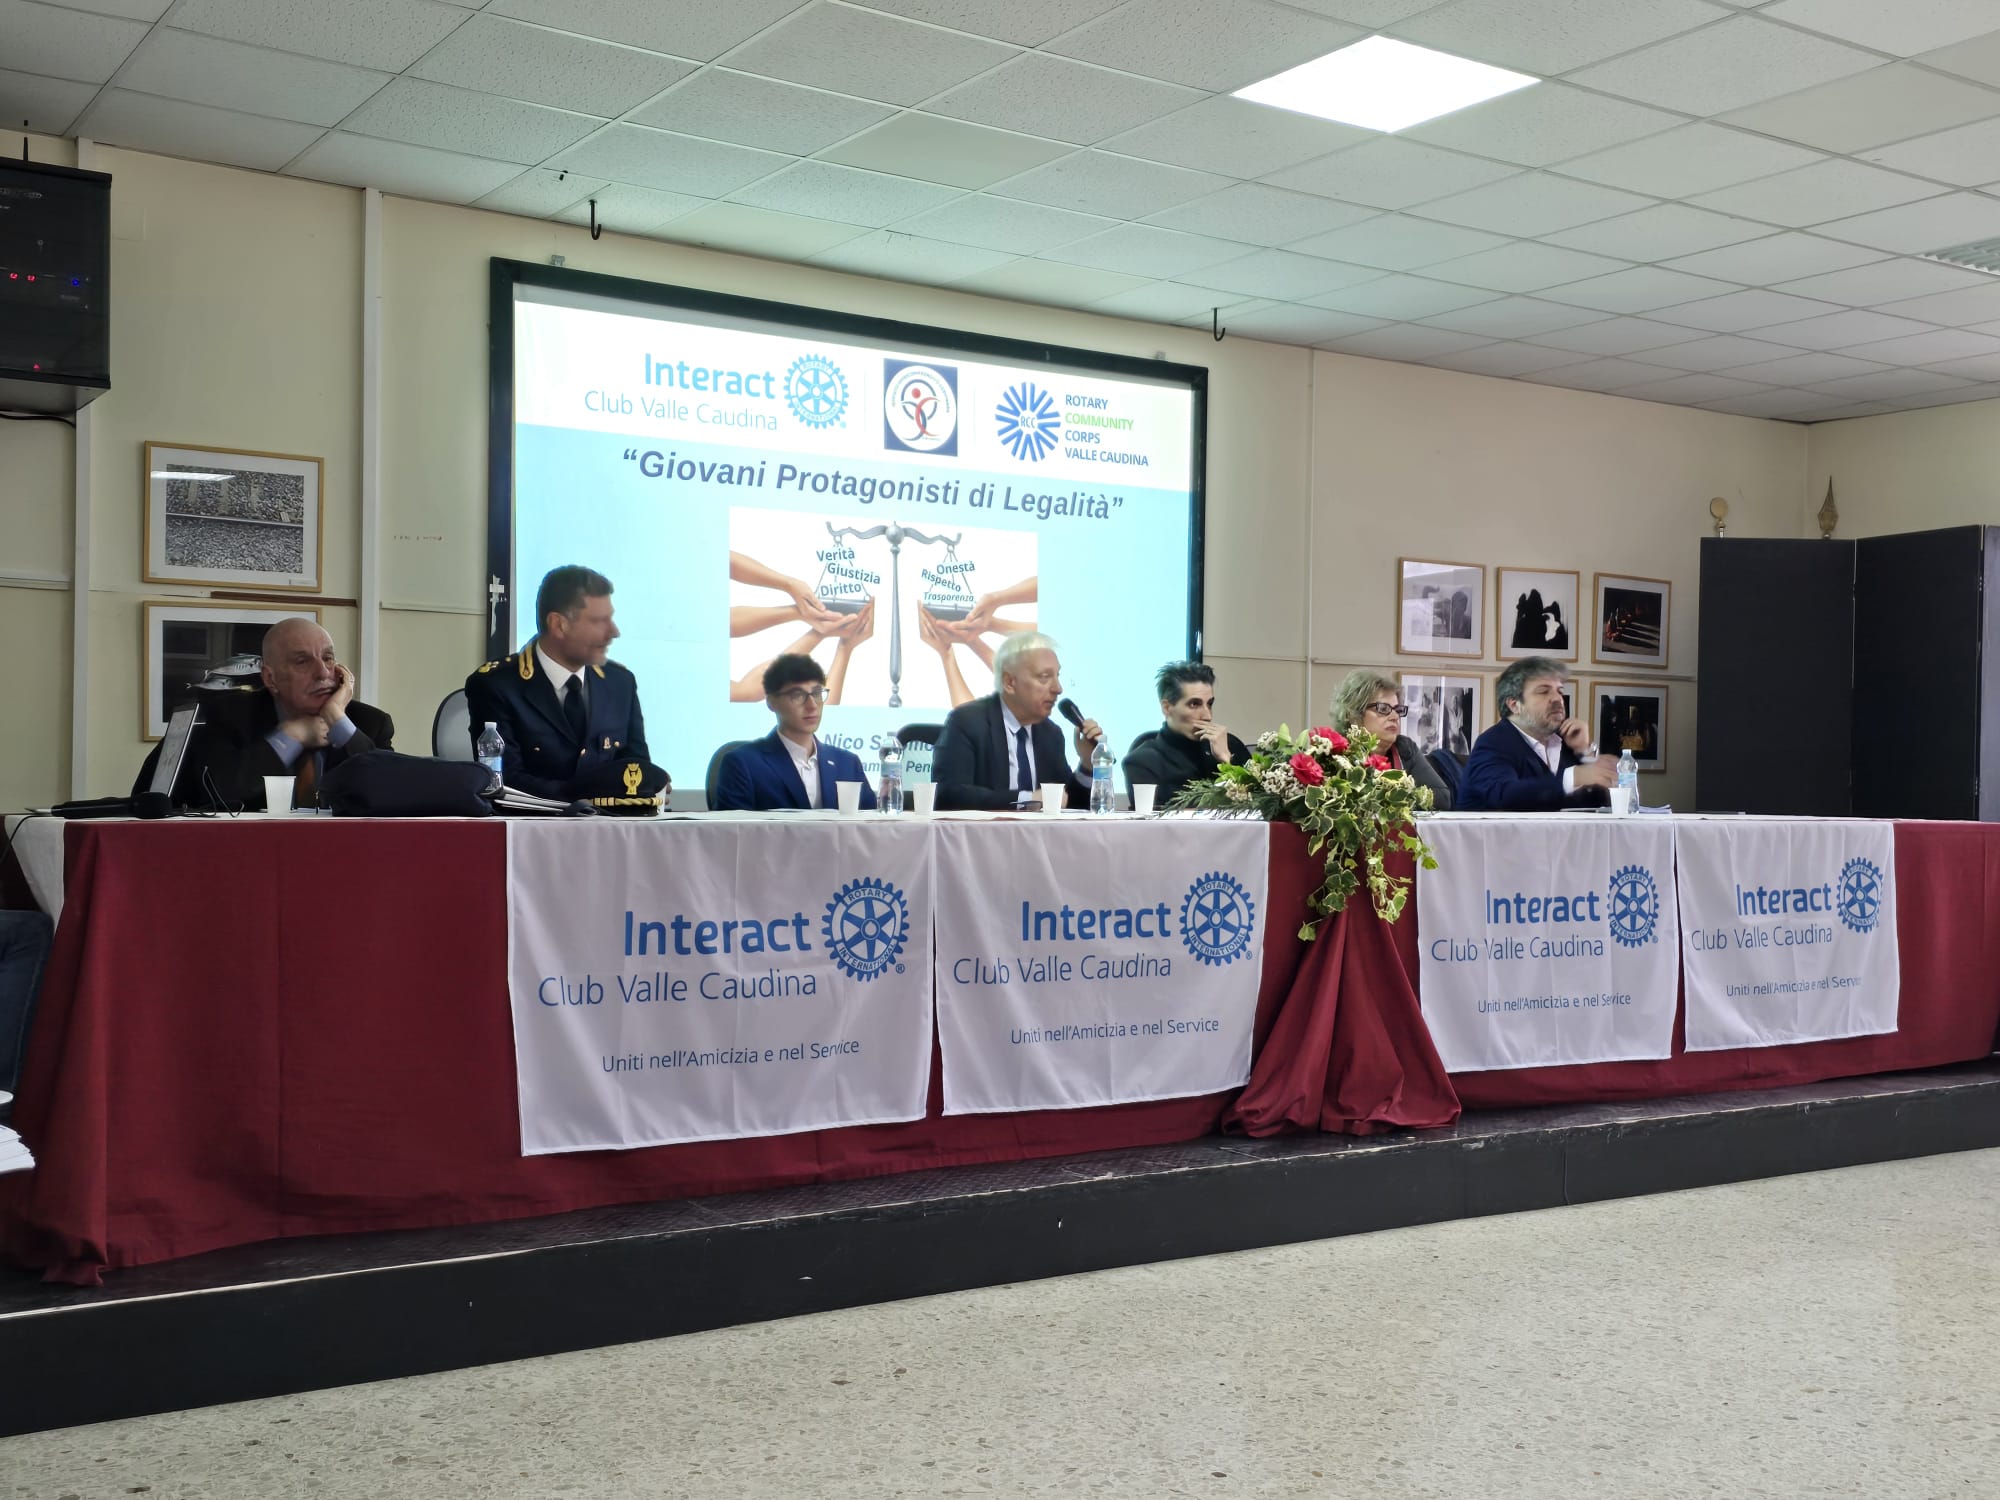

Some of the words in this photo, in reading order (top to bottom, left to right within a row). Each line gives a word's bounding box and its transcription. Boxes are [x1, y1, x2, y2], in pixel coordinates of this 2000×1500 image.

[645, 353, 776, 399] Interact
[584, 390, 634, 415] Club
[641, 396, 689, 421] Valle
[696, 403, 778, 431] Caudina
[1065, 394, 1109, 410] ROTARY
[1020, 416, 1036, 429] RCC
[1065, 412, 1134, 431] COMMUNITY
[1065, 430, 1101, 444] CORPS
[1065, 447, 1098, 461] VALLE
[1099, 450, 1149, 467] CAUDINA
[775, 463, 960, 505] Protagonisti
[968, 483, 996, 509] di
[816, 548, 856, 562] Verità
[827, 562, 881, 585] Giustizia
[936, 560, 976, 575] Onestà
[820, 582, 862, 597] Diritto
[921, 569, 962, 593] Rispetto
[924, 591, 975, 603] Trasparenza
[824, 733, 864, 750] Nico
[848, 888, 888, 902] ROTARY
[1200, 882, 1232, 892] ROTARY
[1486, 890, 1600, 924] Interact
[1737, 883, 1832, 916] Interact
[1022, 901, 1171, 941] Interact
[624, 911, 812, 956] Interact
[1190, 931, 1246, 956] INTERNATIONAL
[1692, 929, 1727, 951] Club
[1734, 925, 1769, 949] Valle
[1773, 923, 1832, 946] Caudina
[838, 943, 896, 971] INTERNATIONAL
[1431, 938, 1478, 962] Club
[1484, 937, 1524, 960] Valle
[1530, 935, 1604, 959] Caudina
[953, 957, 1010, 985] Club
[1017, 955, 1072, 983] Valle
[1080, 953, 1171, 980] Caudina
[538, 973, 604, 1007] Club
[617, 972, 688, 1003] Valle
[700, 968, 817, 1001] Caudina
[1726, 984, 1750, 997] Uniti
[1478, 999, 1500, 1013] Uniti
[1573, 998, 1580, 1008] e
[1583, 994, 1599, 1007] nel
[1011, 1026, 1041, 1044] Uniti
[1130, 1025, 1139, 1036] e
[1142, 1018, 1163, 1036] nel
[1167, 1017, 1219, 1035] Service
[602, 1053, 644, 1073] Uniti
[764, 1050, 773, 1062] e
[779, 1042, 805, 1061] nel
[811, 1039, 860, 1059] Service
